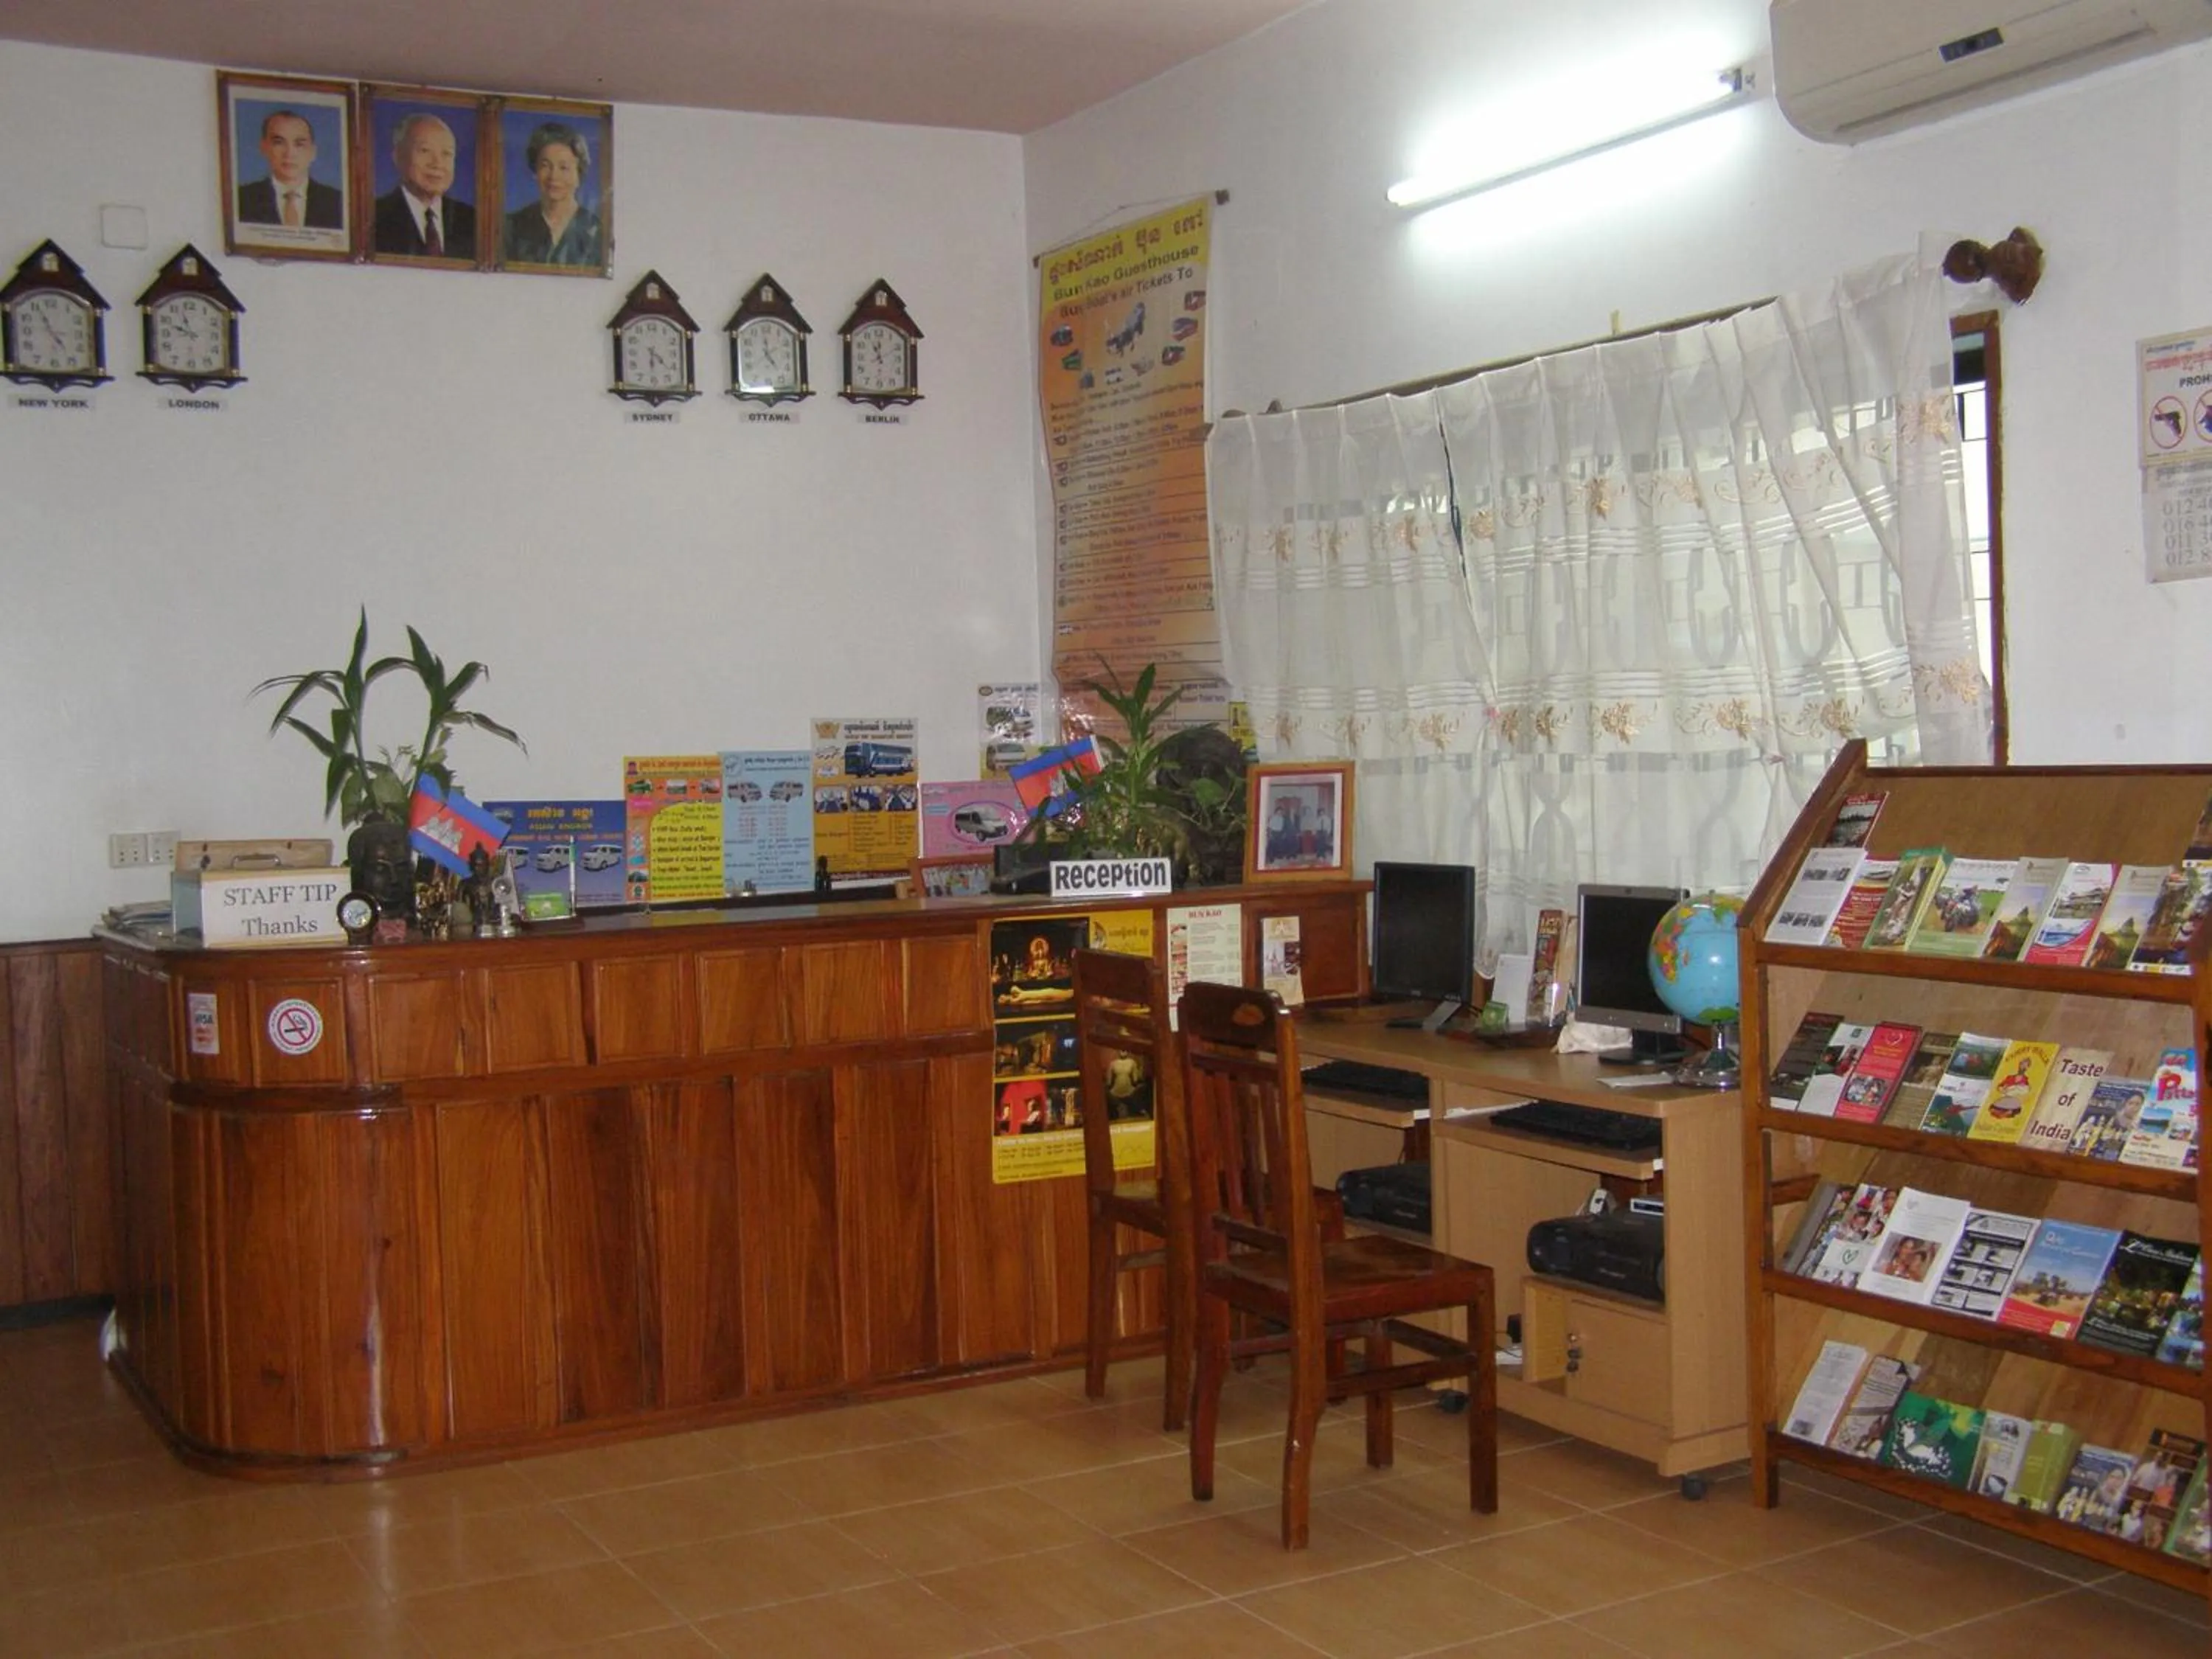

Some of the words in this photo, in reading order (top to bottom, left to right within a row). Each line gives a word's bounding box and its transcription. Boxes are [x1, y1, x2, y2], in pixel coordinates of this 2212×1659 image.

[1113, 245, 1200, 282] Guesthouse
[1178, 266, 1193, 279] To
[18, 398, 48, 407] NEW
[52, 399, 89, 408] YORK
[168, 400, 220, 408] LONDON
[632, 413, 673, 422] SYDNEY
[748, 413, 790, 422] OTTAWA
[865, 415, 900, 423] BERLIN
[1055, 861, 1166, 890] Reception
[224, 886, 296, 906] STAFF
[299, 883, 337, 902] TIP
[241, 914, 318, 936] Thanks
[2060, 1059, 2104, 1077] Taste
[2058, 1093, 2077, 1107] of
[2030, 1120, 2071, 1140] India
